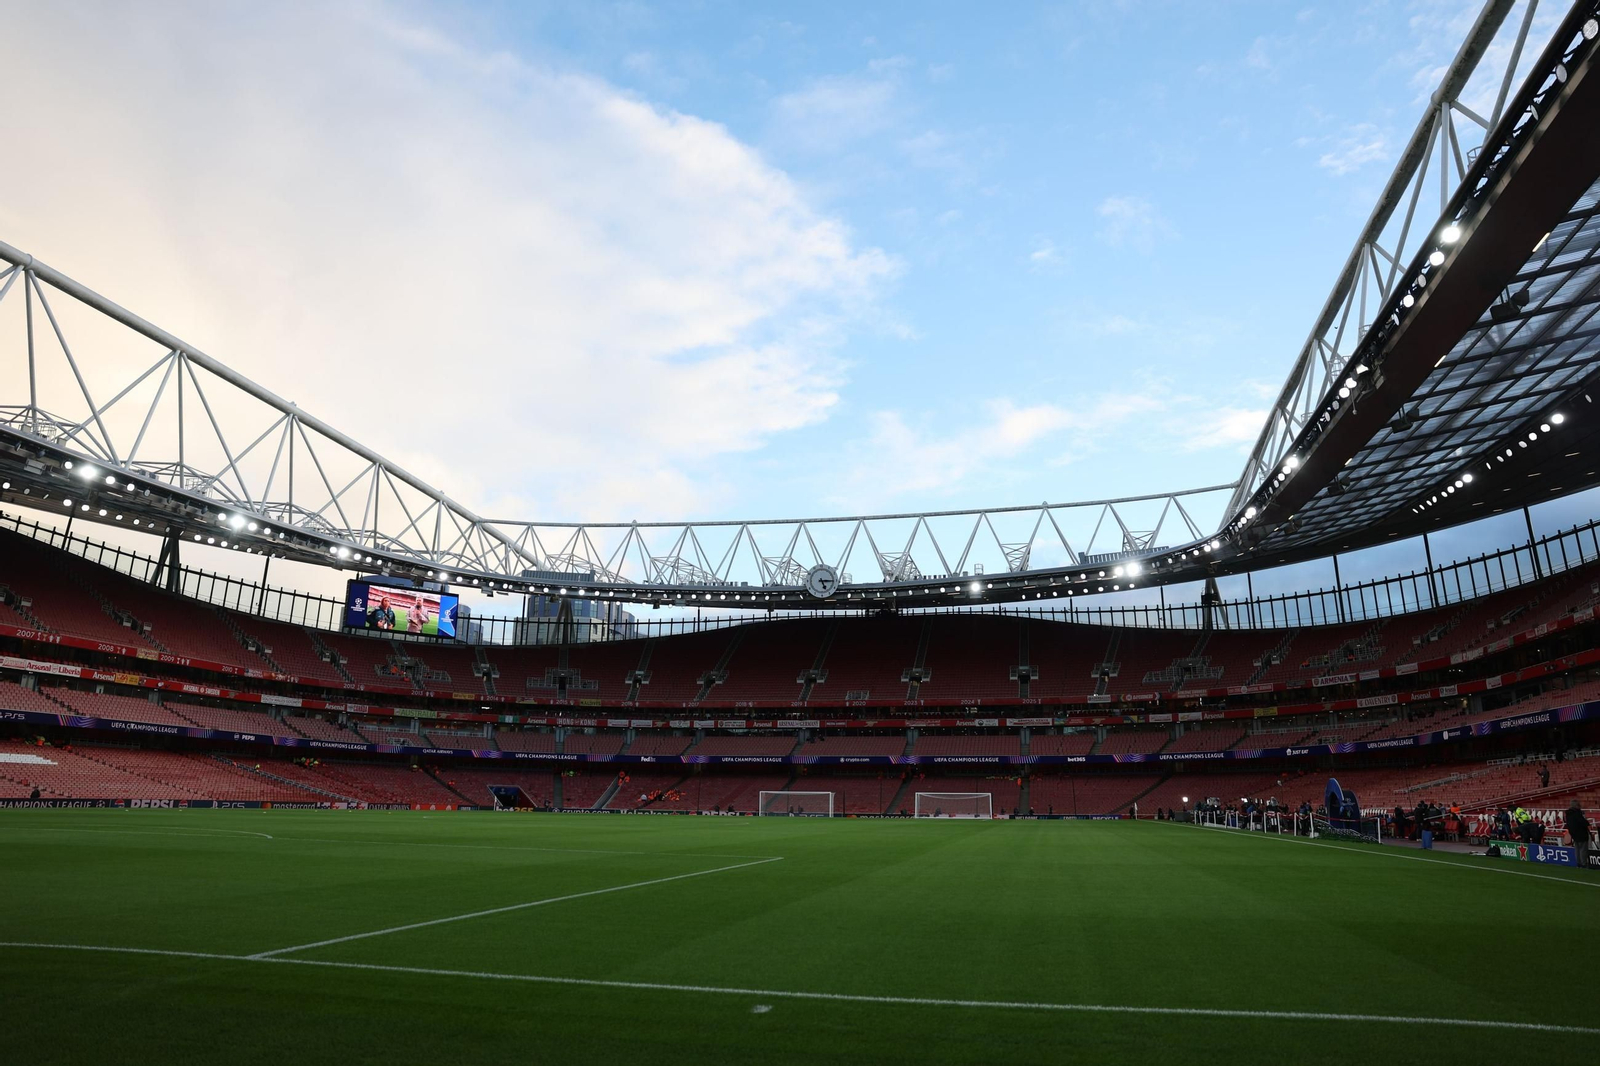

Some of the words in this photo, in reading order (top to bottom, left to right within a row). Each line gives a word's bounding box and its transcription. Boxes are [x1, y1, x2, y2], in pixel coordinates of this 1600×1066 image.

[16, 629, 35, 638] 2007
[98, 643, 114, 652] 2008
[26, 662, 51, 672] Arsenal
[58, 666, 80, 676] Liberia
[92, 672, 115, 681] Arsenal
[1320, 676, 1349, 685] ARMENIA
[183, 684, 199, 693] ARSENAL
[205, 687, 220, 696] SWEDEN
[1411, 691, 1431, 701] Arsenal
[1364, 697, 1391, 706] DAVENTRY
[400, 709, 436, 718] AUSTRALIA
[1509, 717, 1532, 727] CHAMPIONS
[1533, 714, 1550, 723] LEAGUE
[130, 800, 174, 808] PEPSI
[1547, 849, 1569, 862] PS5
